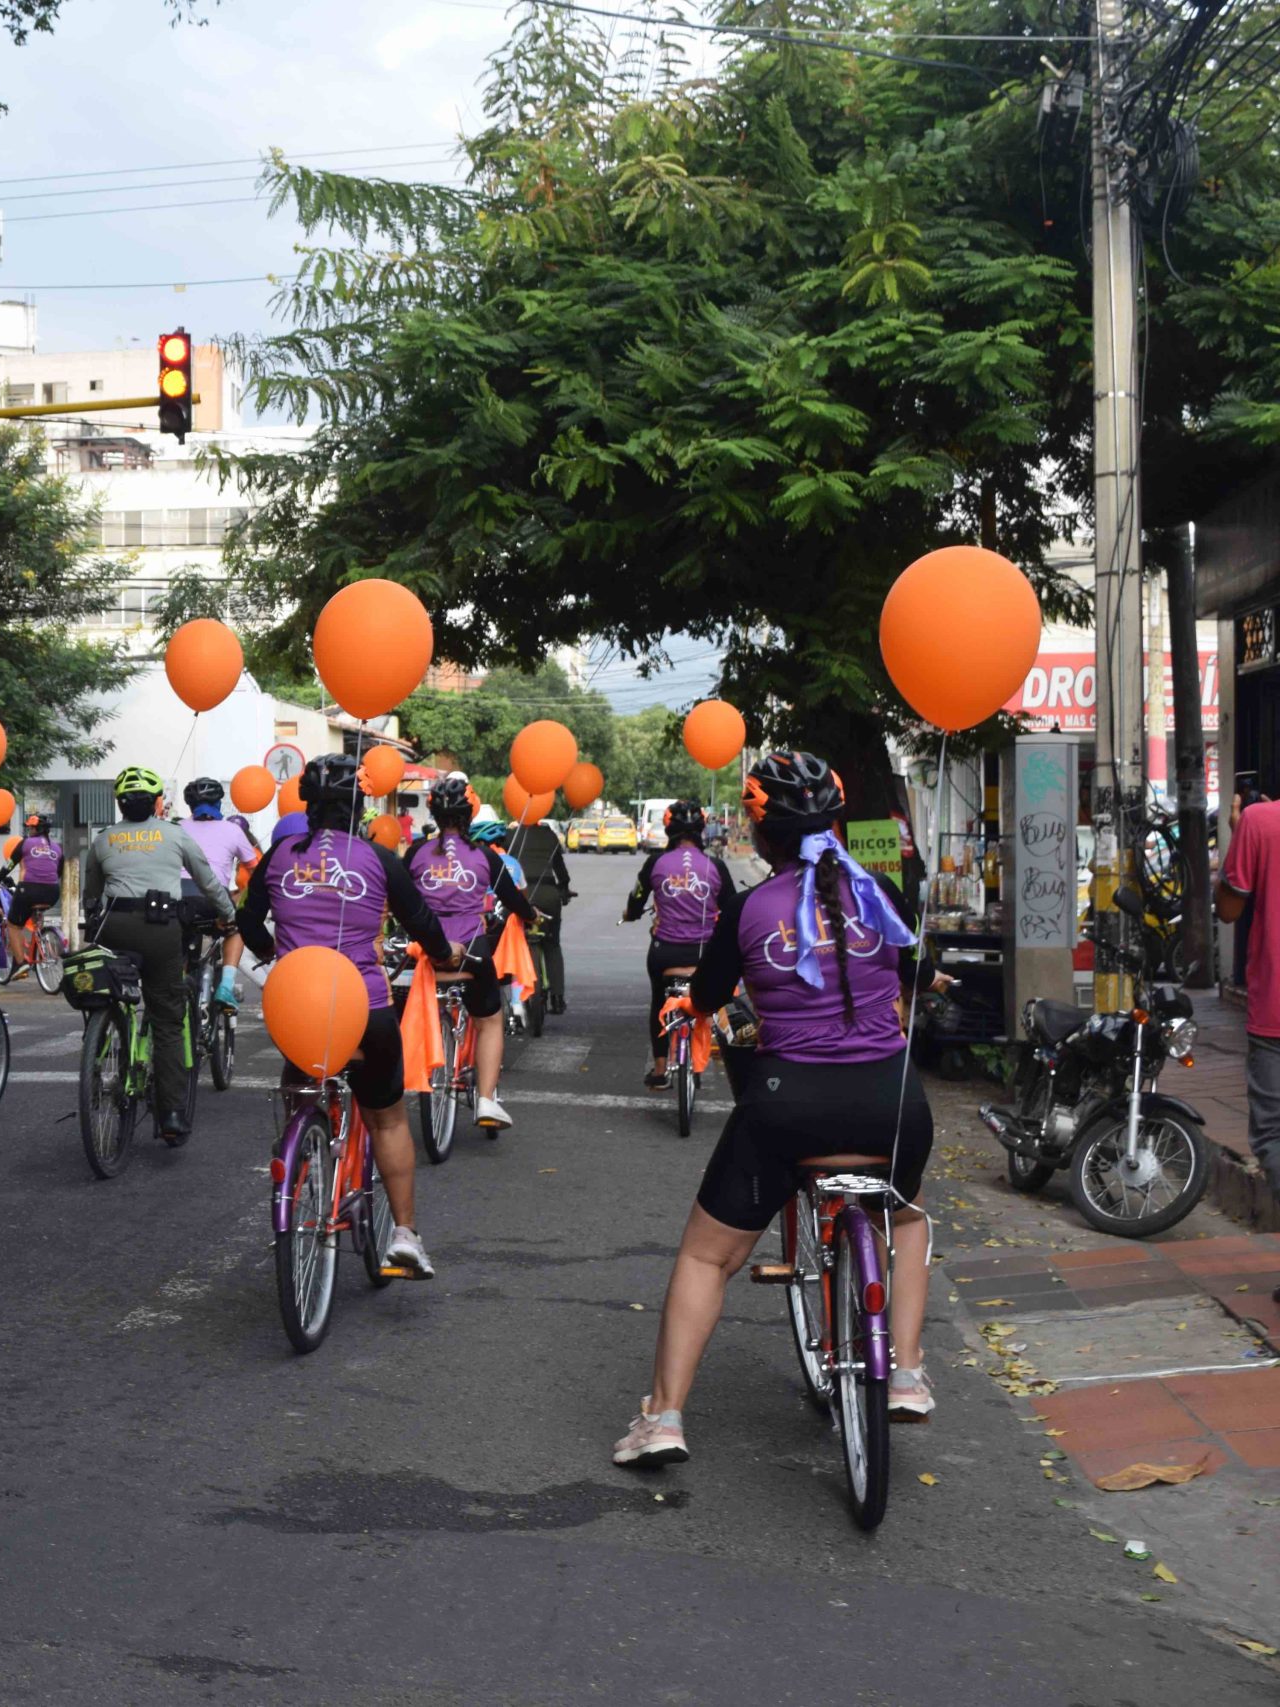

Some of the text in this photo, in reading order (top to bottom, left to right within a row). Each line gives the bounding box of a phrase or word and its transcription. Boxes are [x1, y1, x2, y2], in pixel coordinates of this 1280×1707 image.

[1065, 714, 1087, 727] MAS
[108, 829, 163, 847] POLICIA
[850, 837, 897, 850] RICOS
